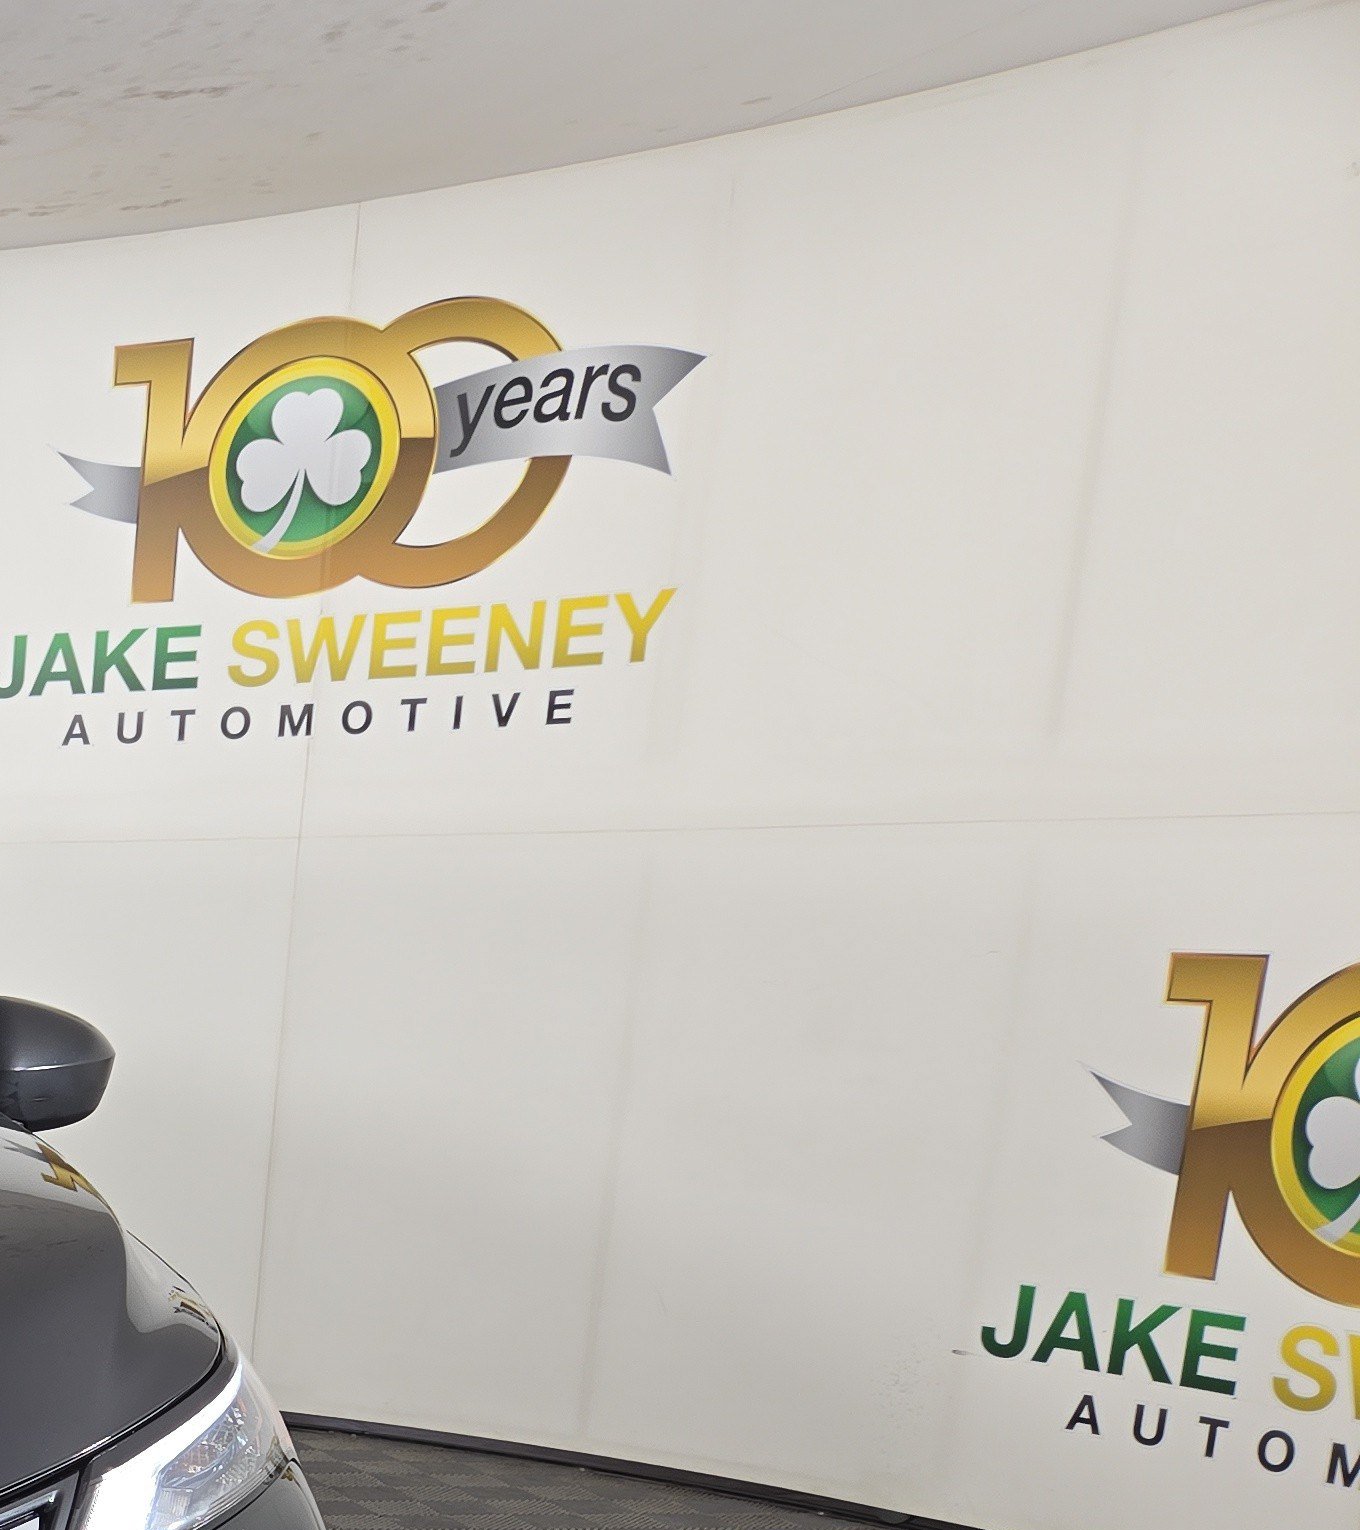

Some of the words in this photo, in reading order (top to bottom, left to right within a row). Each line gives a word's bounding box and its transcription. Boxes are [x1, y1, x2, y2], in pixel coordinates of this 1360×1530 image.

[449, 362, 643, 458] years
[226, 587, 678, 688] SWEENEY
[61, 688, 575, 747] AUTOMOTIVE
[980, 1284, 1247, 1396] JAKE
[1271, 1324, 1360, 1420] S
[1066, 1394, 1360, 1488] AUTOM
